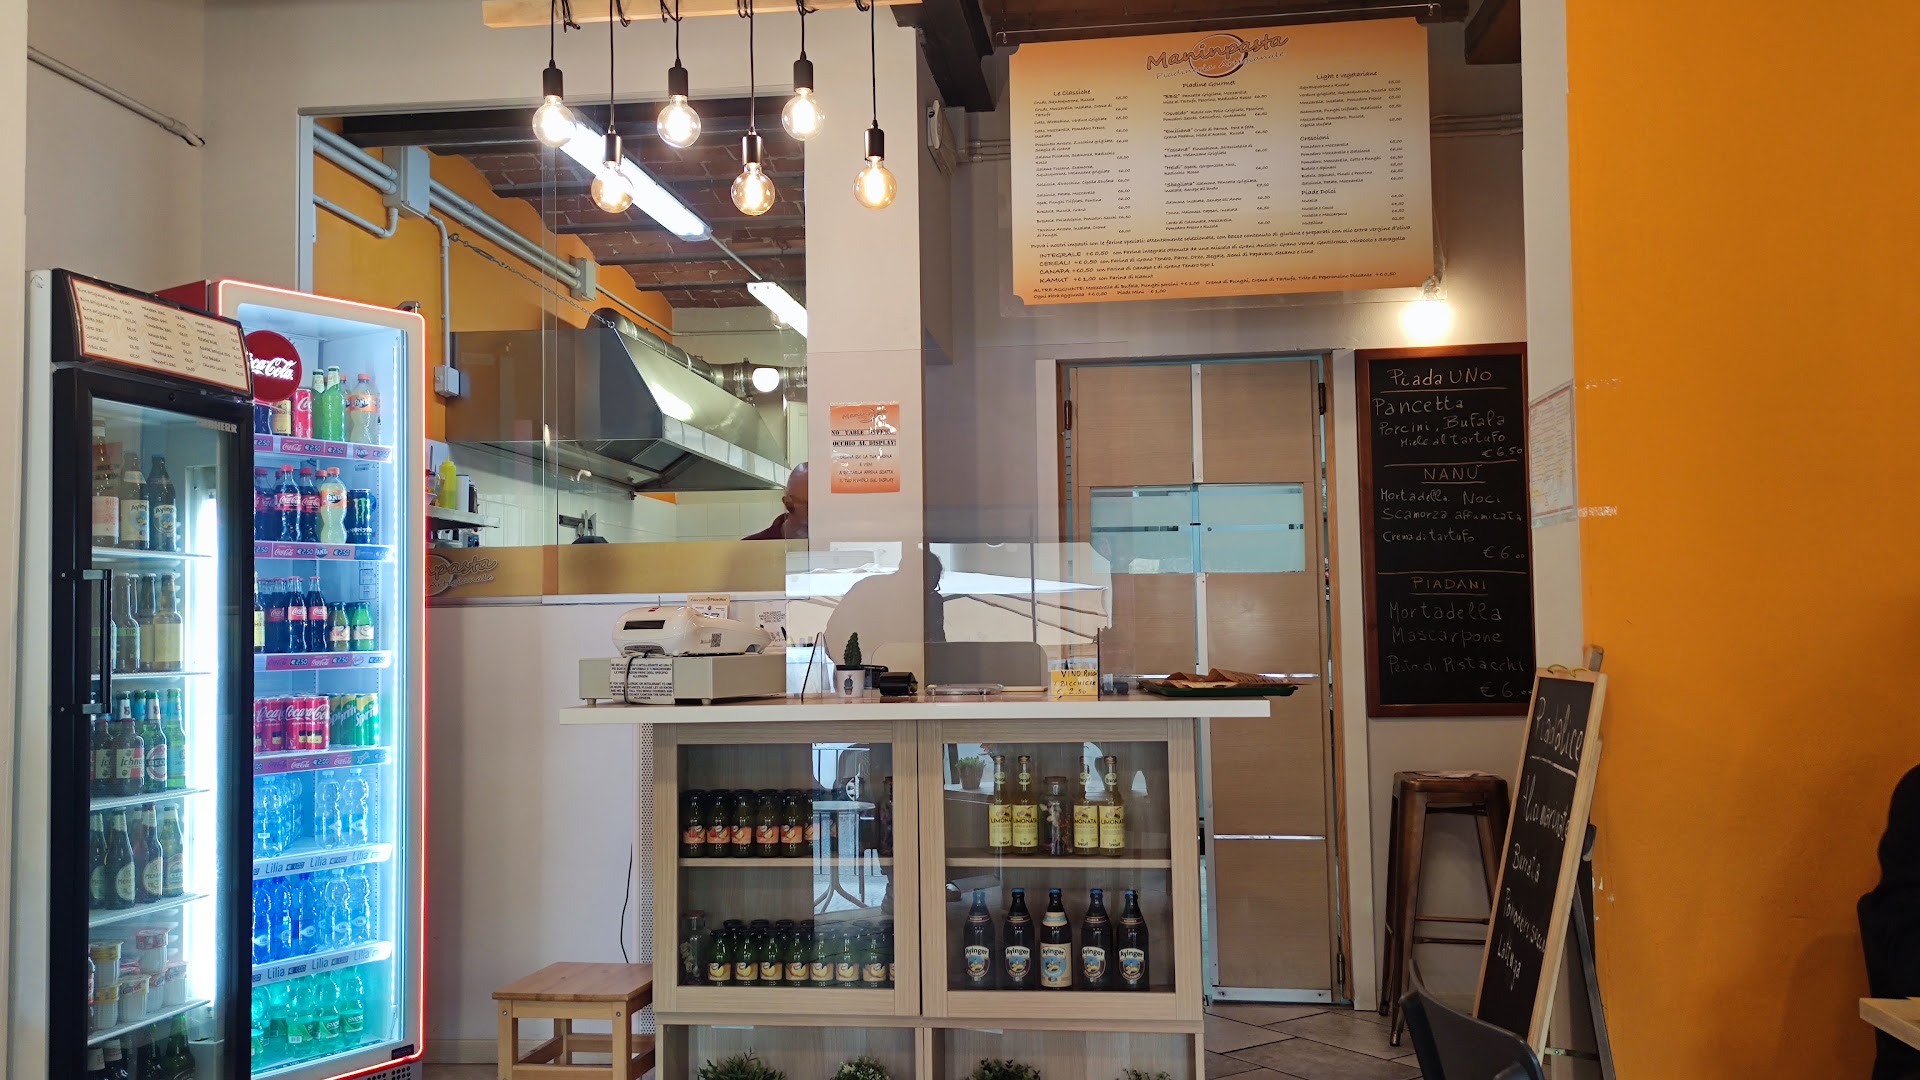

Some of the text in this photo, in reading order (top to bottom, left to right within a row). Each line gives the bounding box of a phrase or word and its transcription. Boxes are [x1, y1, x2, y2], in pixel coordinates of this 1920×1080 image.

[1147, 34, 1289, 70] Maninpasta
[1106, 240, 1123, 248] farine
[1369, 225, 1390, 233] vergine
[1387, 367, 1492, 386] Piada UNO
[1373, 396, 1464, 416] Pancetta
[1433, 434, 1447, 446] al
[1381, 508, 1522, 521] Scamorza affumicata
[1383, 527, 1475, 543] Crema di tartufo
[1411, 576, 1486, 590] PIADANI
[1389, 601, 1502, 622] Mortadella
[1392, 626, 1503, 648] Mascarpone
[1442, 656, 1524, 672] Pistacchi
[1061, 670, 1081, 678] VINO
[265, 863, 283, 874] Lilia
[310, 856, 327, 868] Lilia
[966, 947, 988, 955] Ayinger
[1006, 947, 1029, 955] Ayinger
[1043, 948, 1064, 956] Ayinger
[1082, 948, 1103, 956] Ayinger
[1121, 950, 1143, 958] Ayinger
[311, 957, 328, 971] Lilia
[267, 966, 285, 980] Lilia
